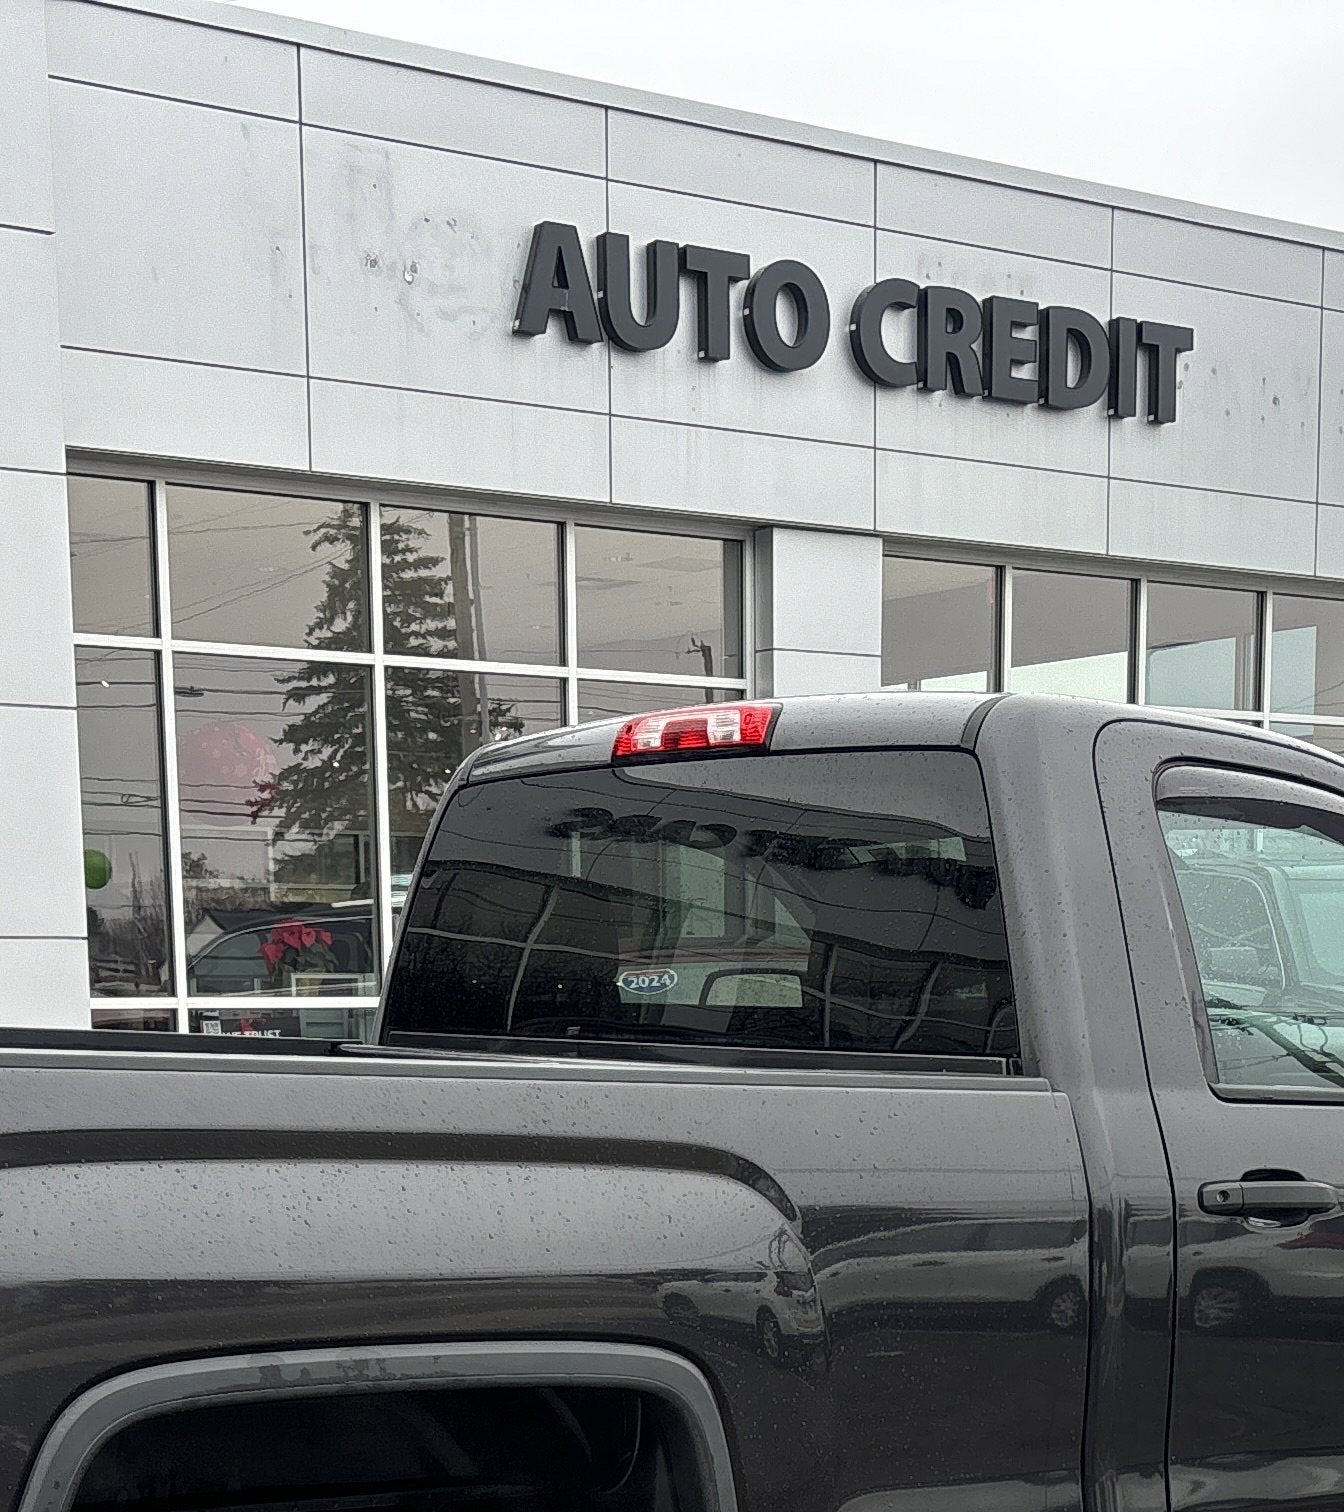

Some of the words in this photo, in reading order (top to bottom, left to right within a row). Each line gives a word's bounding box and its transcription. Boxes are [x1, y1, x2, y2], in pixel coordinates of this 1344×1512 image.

[513, 221, 830, 372] AUTO
[850, 278, 1193, 424] CREDIT
[628, 974, 671, 988] 2024
